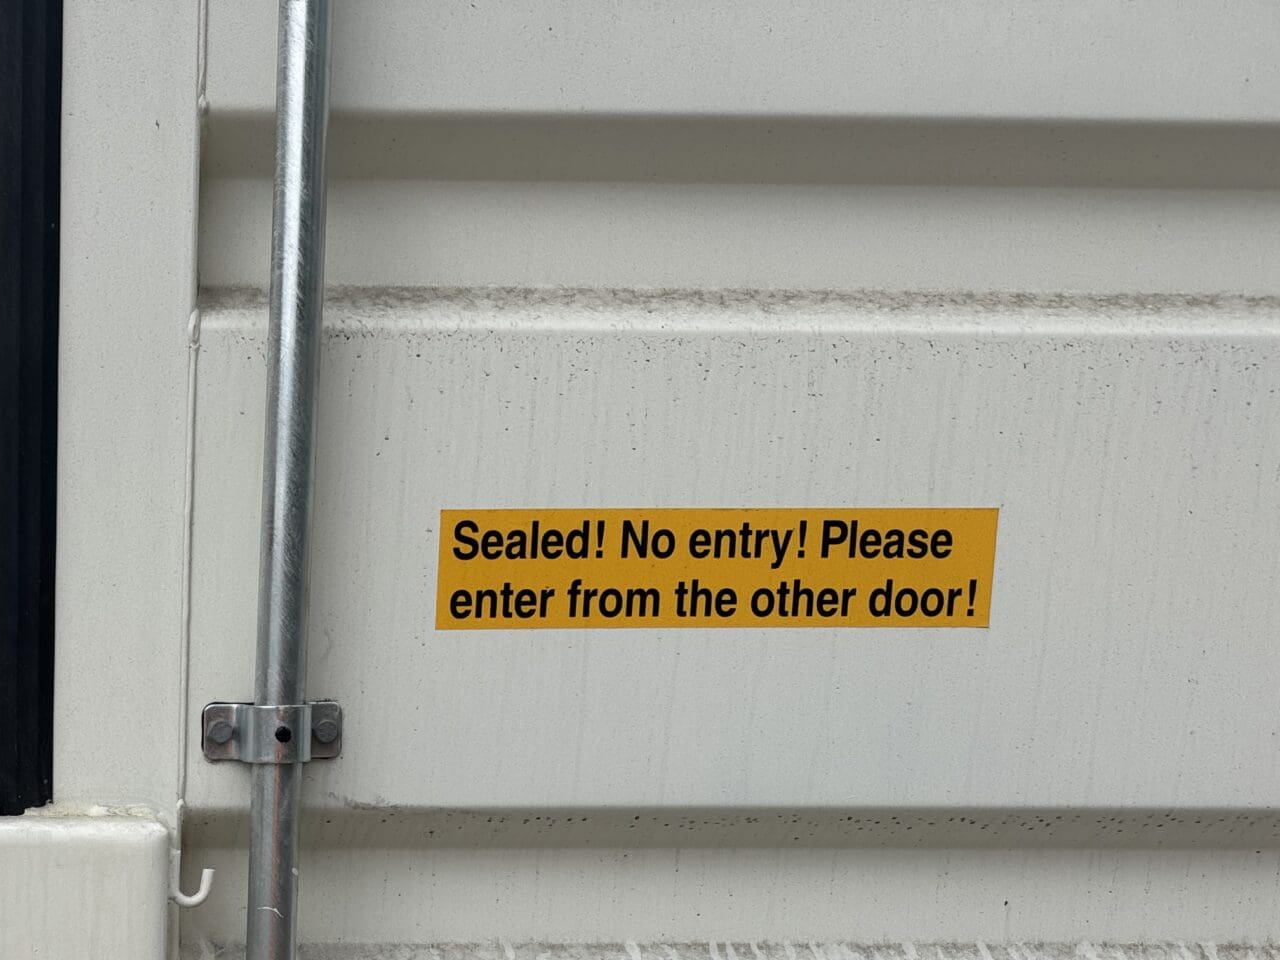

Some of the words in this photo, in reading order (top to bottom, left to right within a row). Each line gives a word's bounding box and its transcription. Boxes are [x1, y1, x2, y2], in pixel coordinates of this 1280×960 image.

[452, 519, 607, 561] Sealed!
[620, 519, 677, 560] No
[688, 519, 808, 570] entry!
[820, 519, 953, 560] Please
[449, 582, 556, 620] enter
[566, 578, 661, 619] from
[674, 578, 738, 618] the
[750, 578, 857, 618] other
[868, 578, 978, 618] door!
